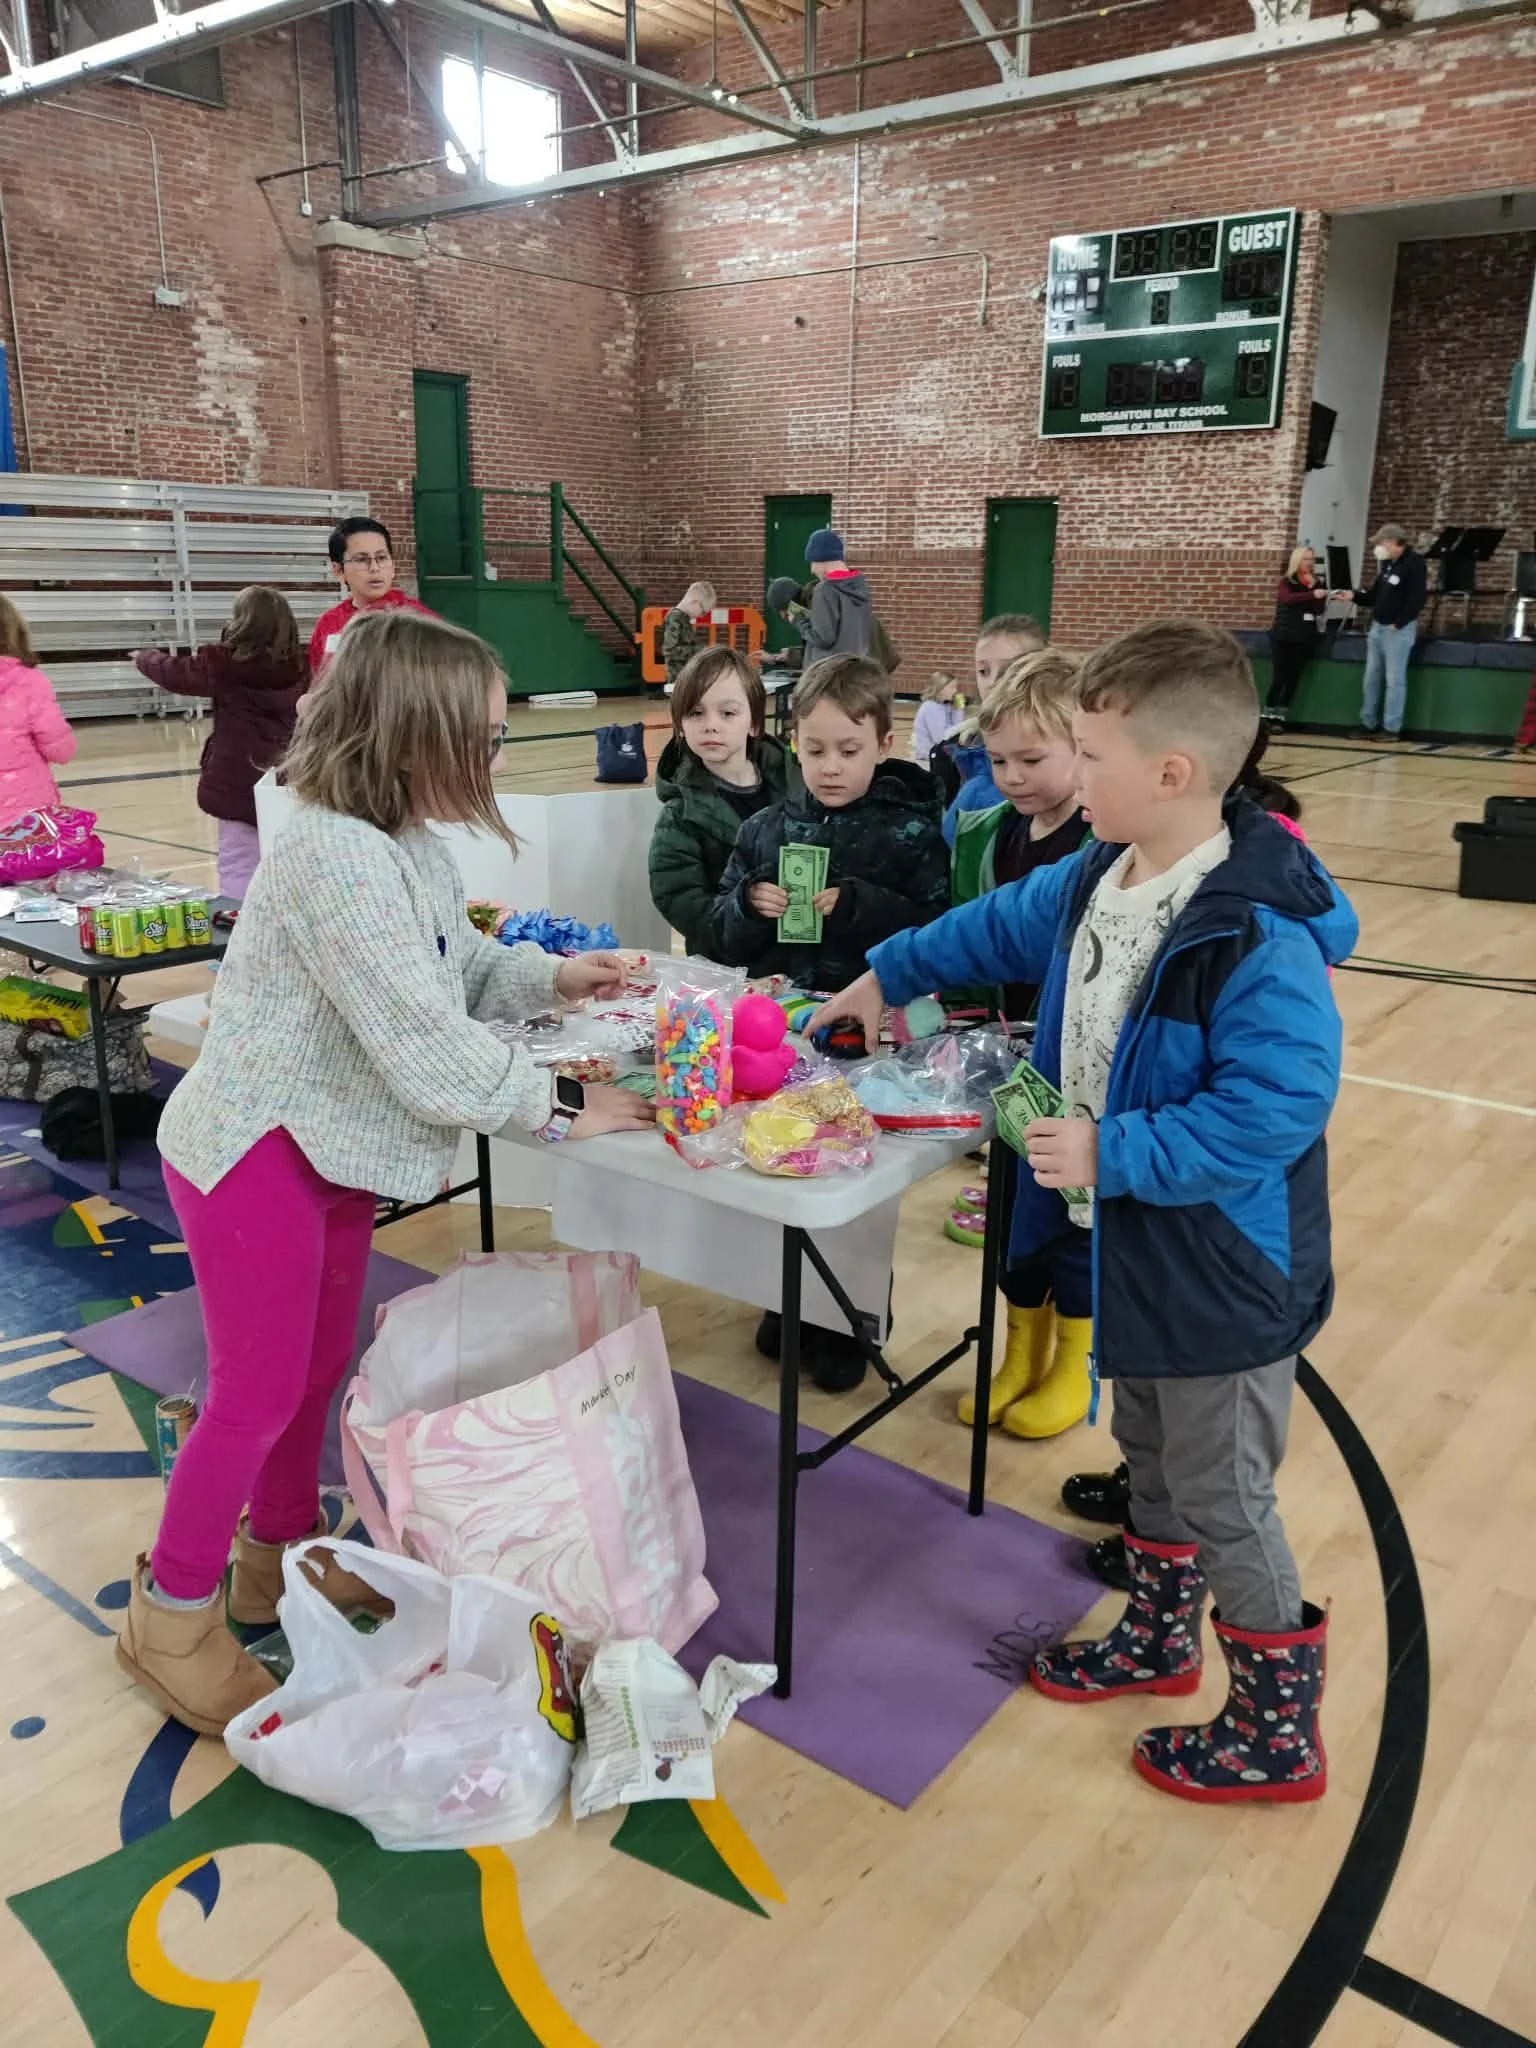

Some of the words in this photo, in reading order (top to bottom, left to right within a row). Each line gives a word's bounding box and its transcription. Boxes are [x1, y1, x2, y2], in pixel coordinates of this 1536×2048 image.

[1228, 220, 1288, 252] GUEST
[1238, 339, 1272, 354] FOULS
[1052, 354, 1081, 368] FOULS
[1080, 409, 1151, 422] MORGANTON
[1154, 407, 1177, 418] DAY
[1179, 404, 1229, 417] SCHOOL
[614, 1365, 636, 1388] Day
